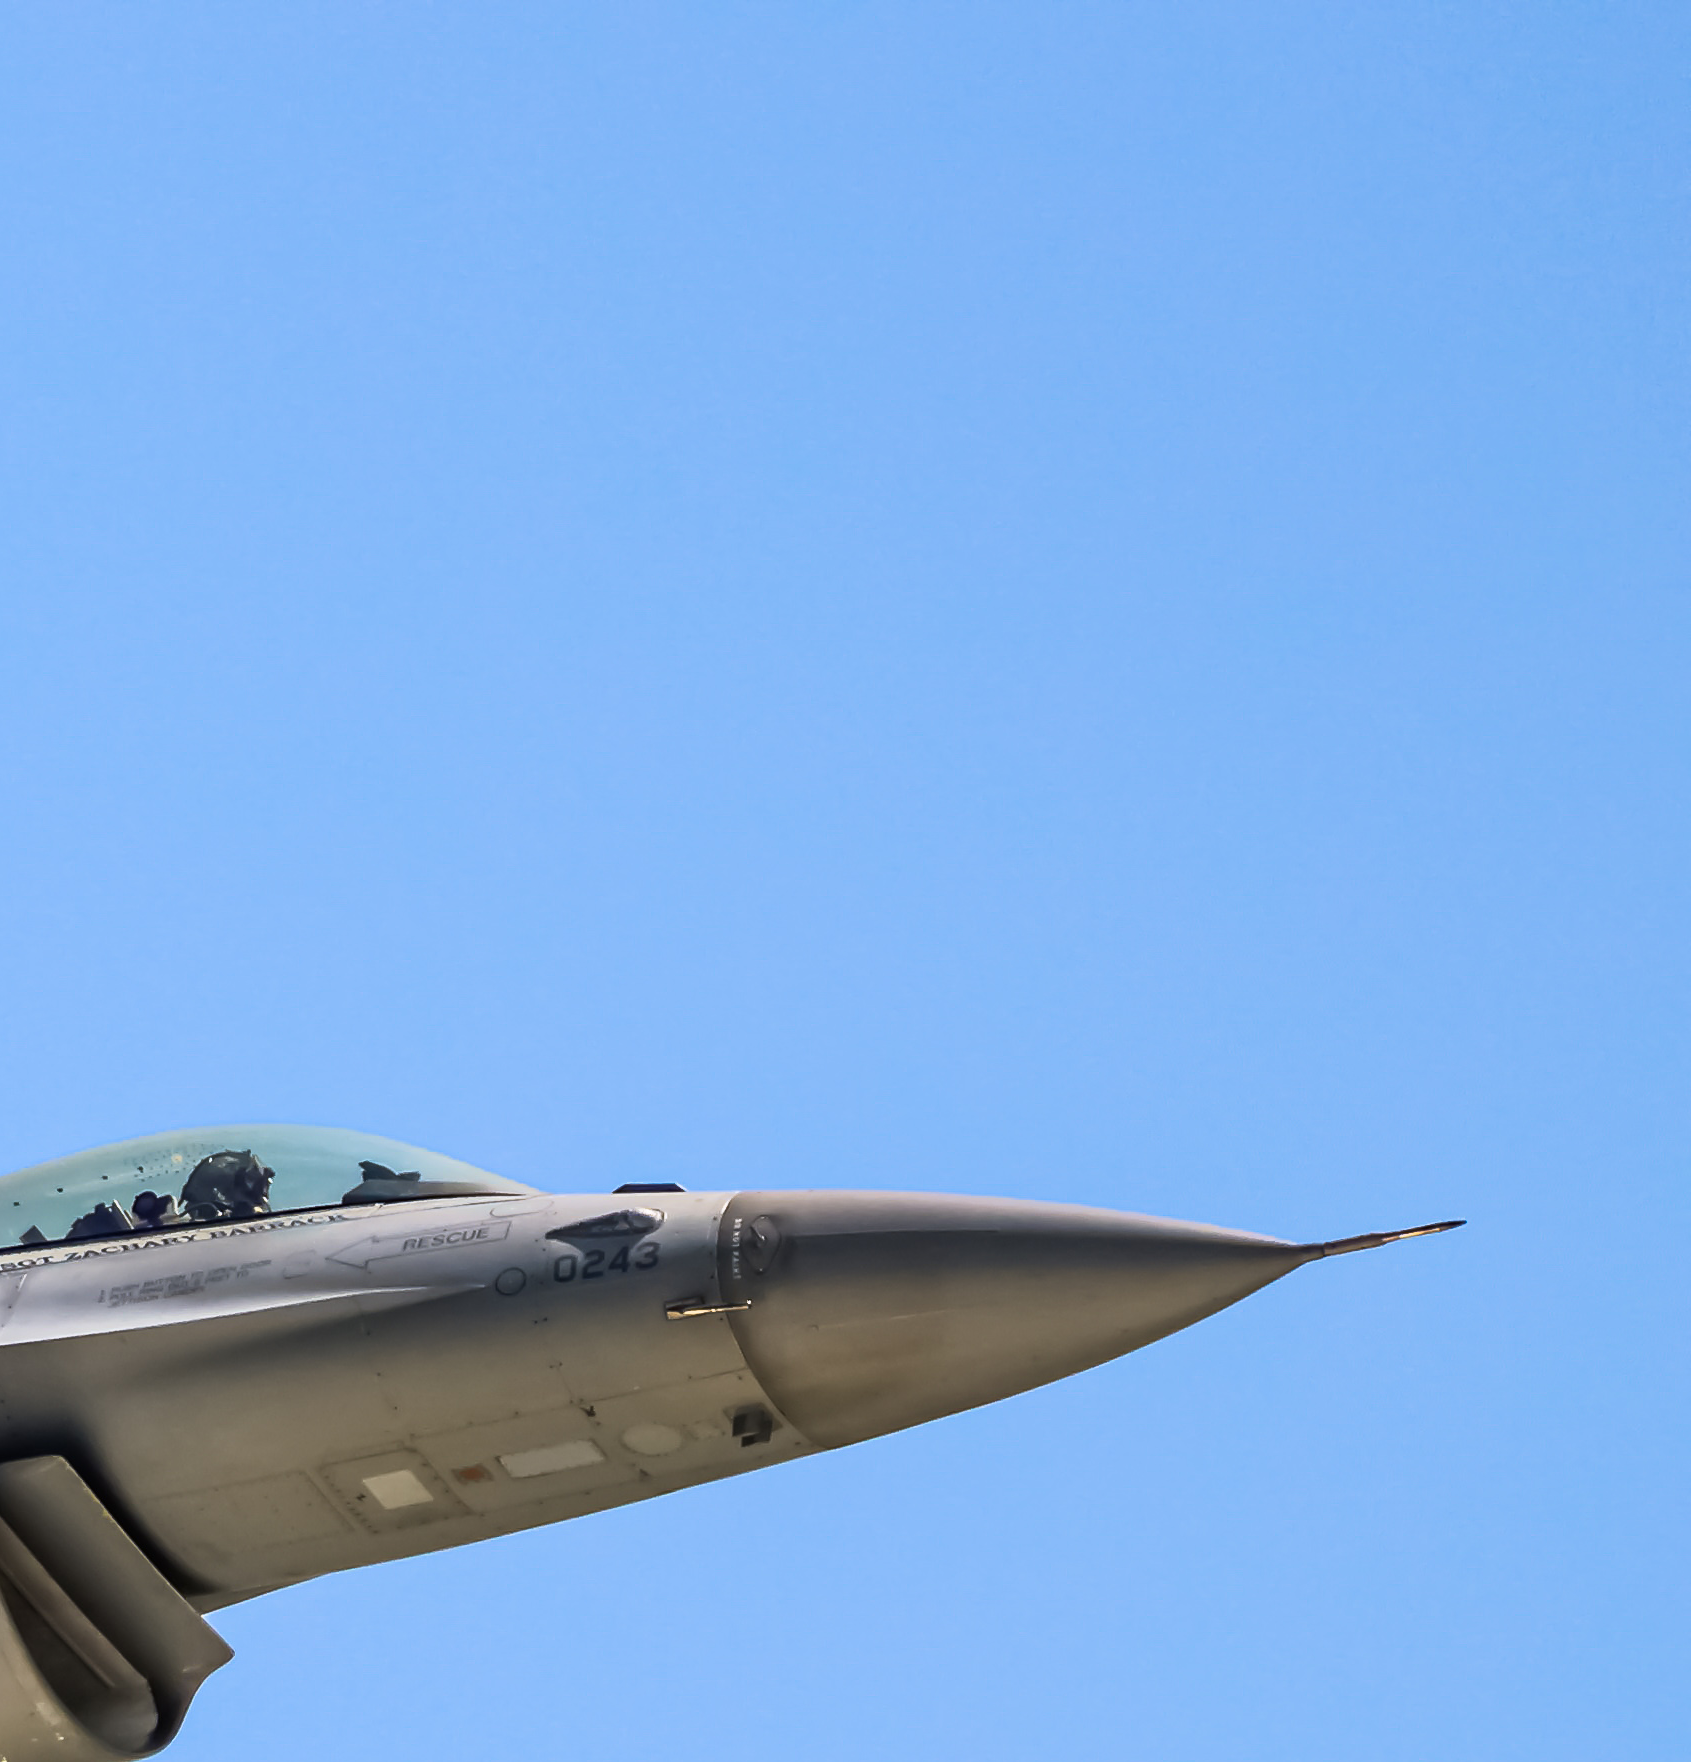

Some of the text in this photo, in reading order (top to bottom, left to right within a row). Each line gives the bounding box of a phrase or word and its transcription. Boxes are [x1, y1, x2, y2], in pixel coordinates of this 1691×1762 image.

[64, 1234, 196, 1263] ZACHARY
[402, 1226, 490, 1251] RESCUE
[553, 1241, 662, 1283] 0243
